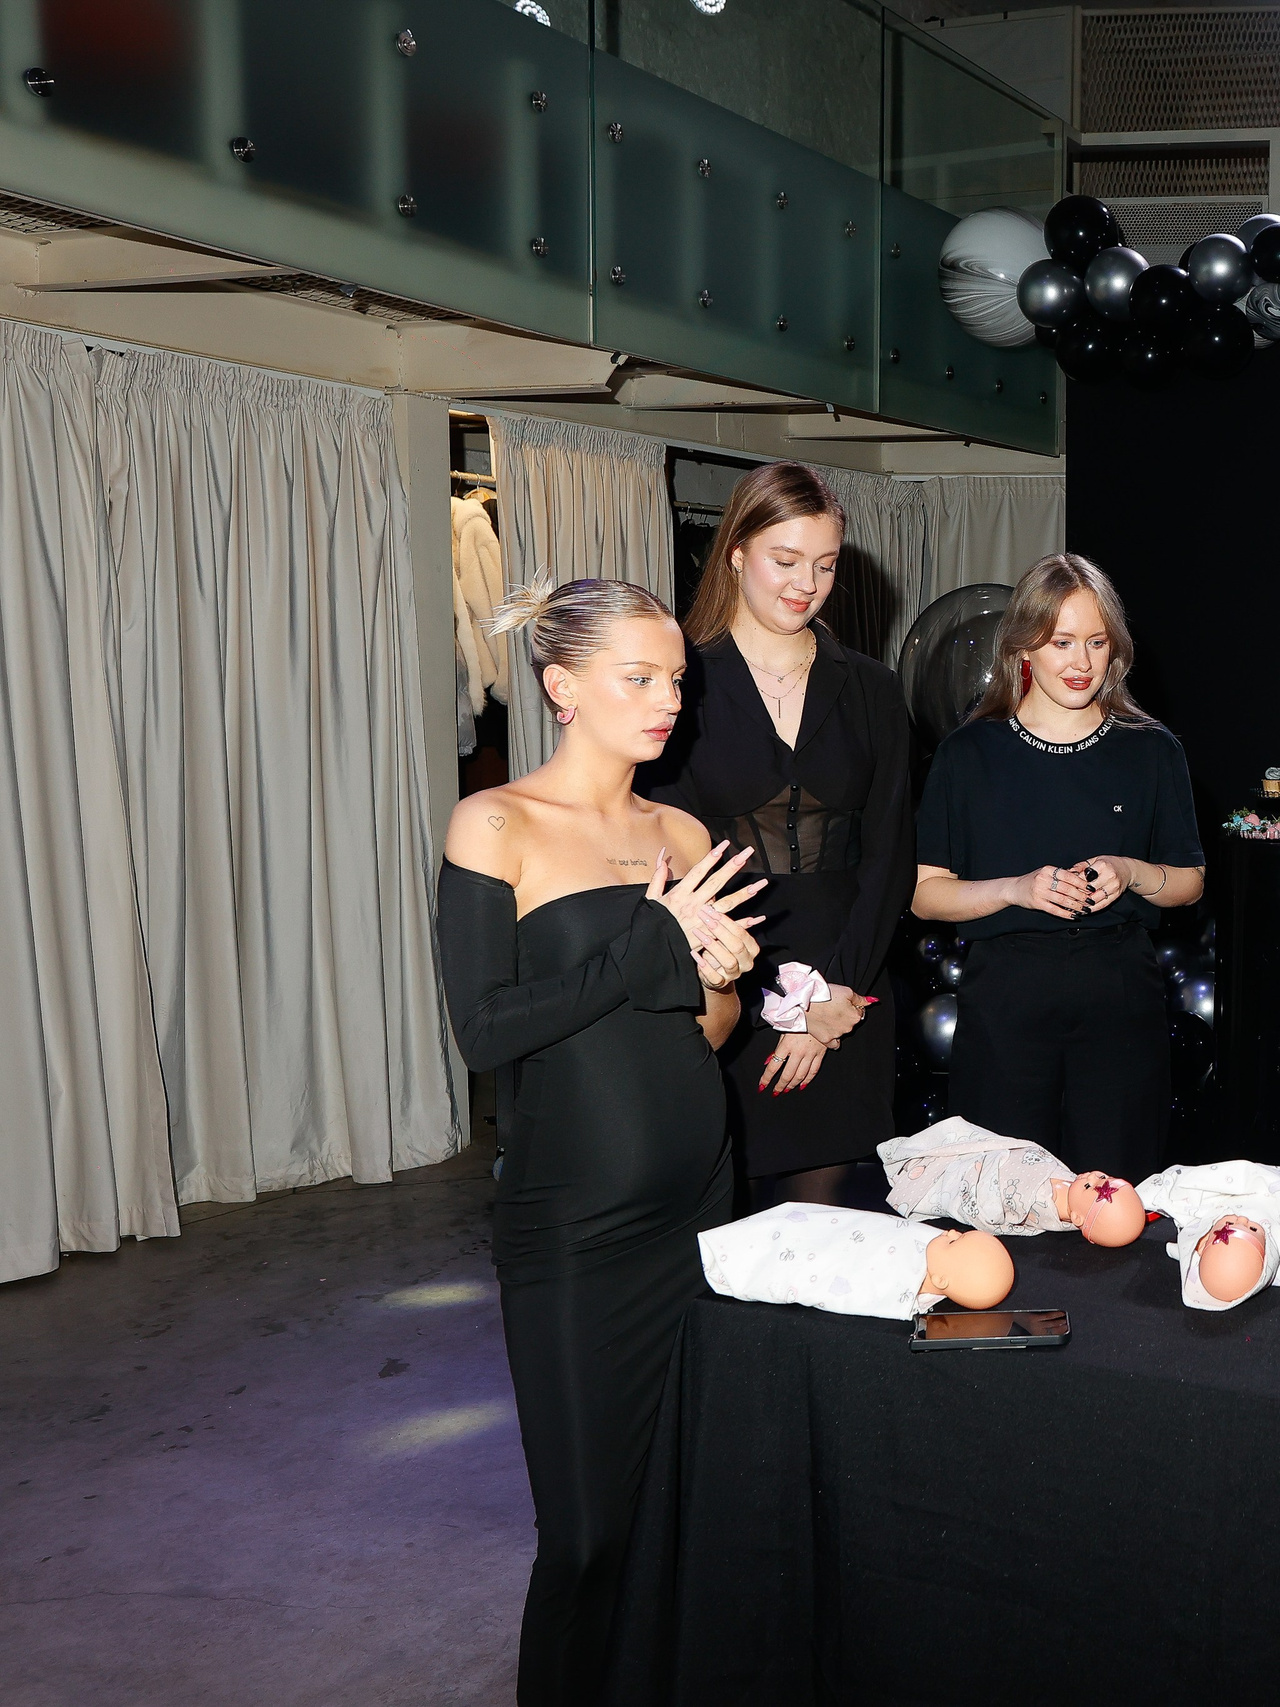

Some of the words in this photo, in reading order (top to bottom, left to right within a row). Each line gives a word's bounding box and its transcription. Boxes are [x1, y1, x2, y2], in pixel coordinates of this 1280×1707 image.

[1008, 715, 1020, 732] ANS
[1019, 730, 1047, 752] CALVIN
[1047, 744, 1073, 754] KLEIN
[1075, 735, 1100, 752] JEANS
[1113, 804, 1123, 812] CK
